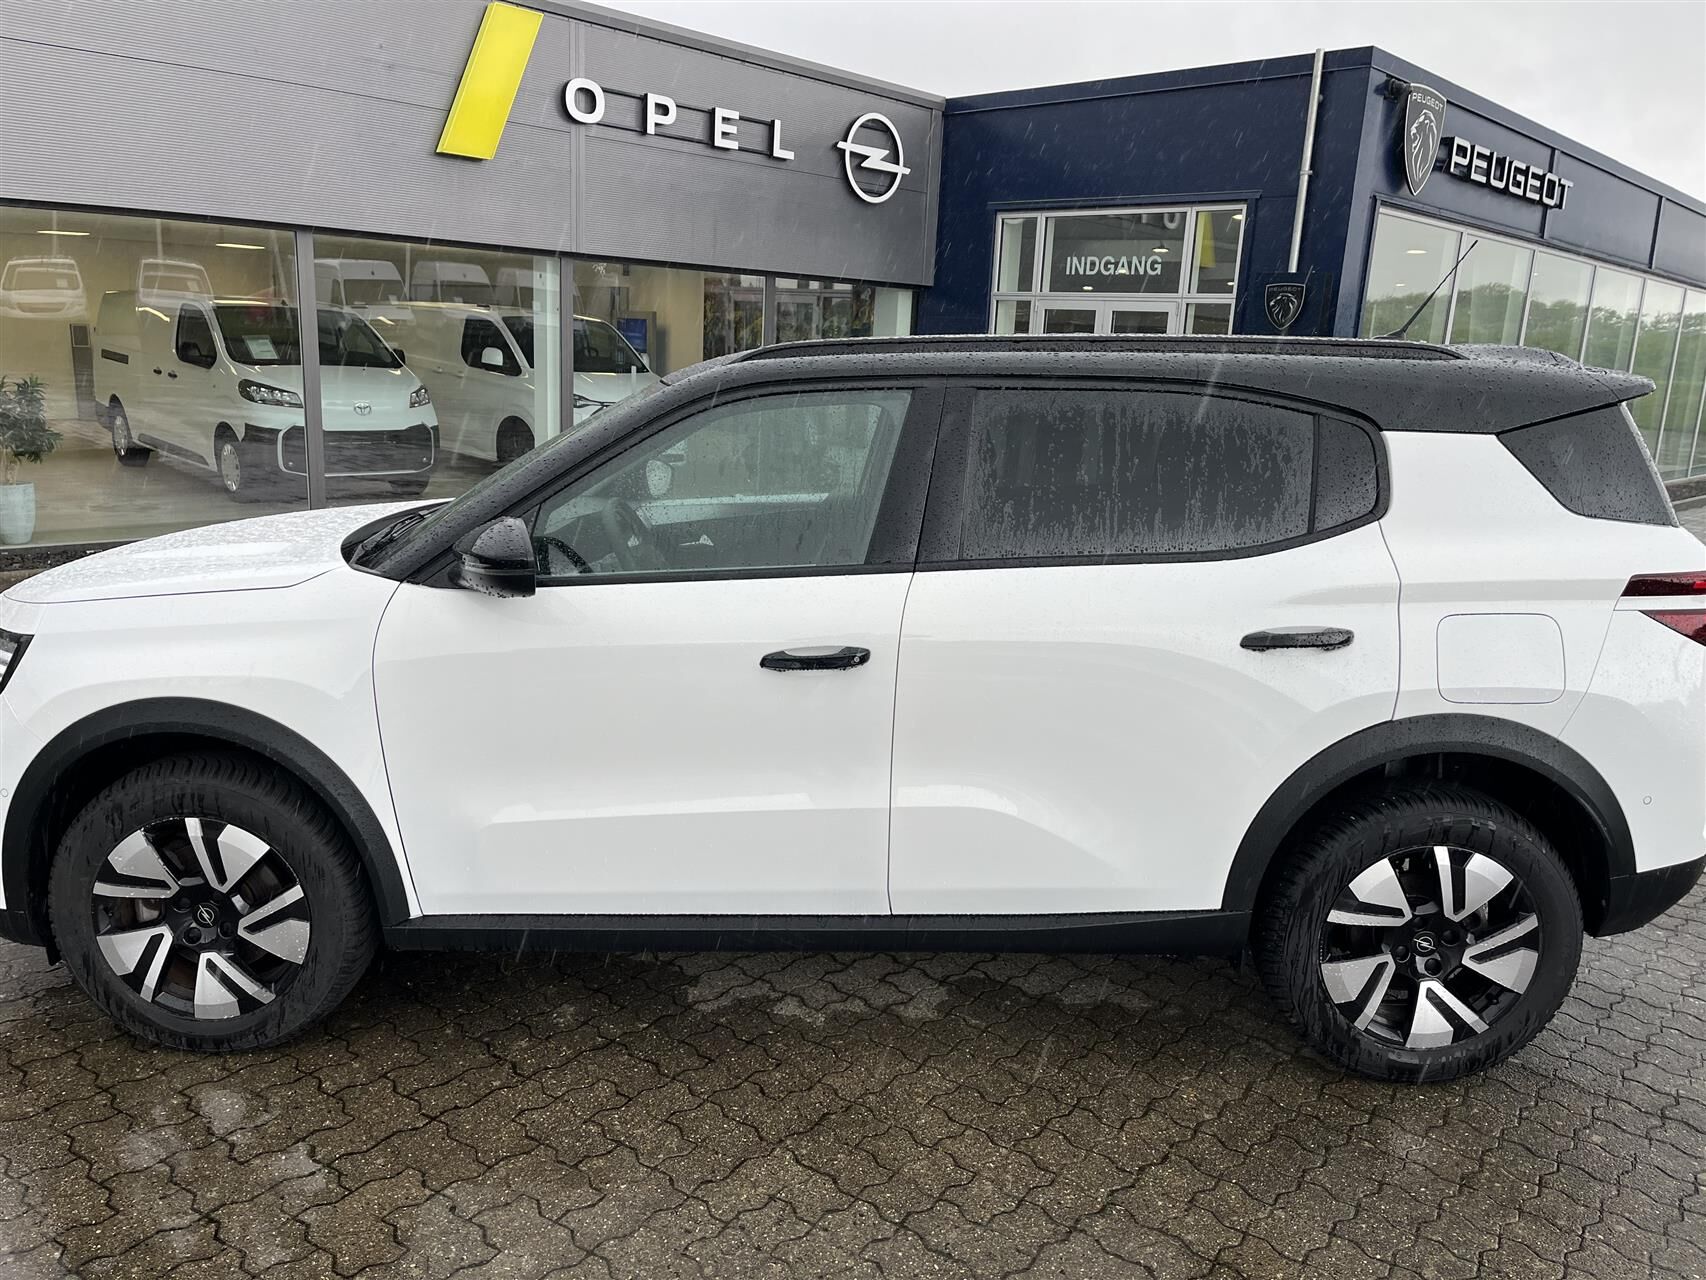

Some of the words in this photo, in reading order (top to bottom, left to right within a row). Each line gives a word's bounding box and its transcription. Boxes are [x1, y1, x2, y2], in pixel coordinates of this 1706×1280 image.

[565, 77, 795, 161] OPEL
[1411, 92, 1444, 112] PEUGEOT
[1450, 136, 1574, 210] PEUGEOT
[1065, 255, 1163, 276] INDGANG
